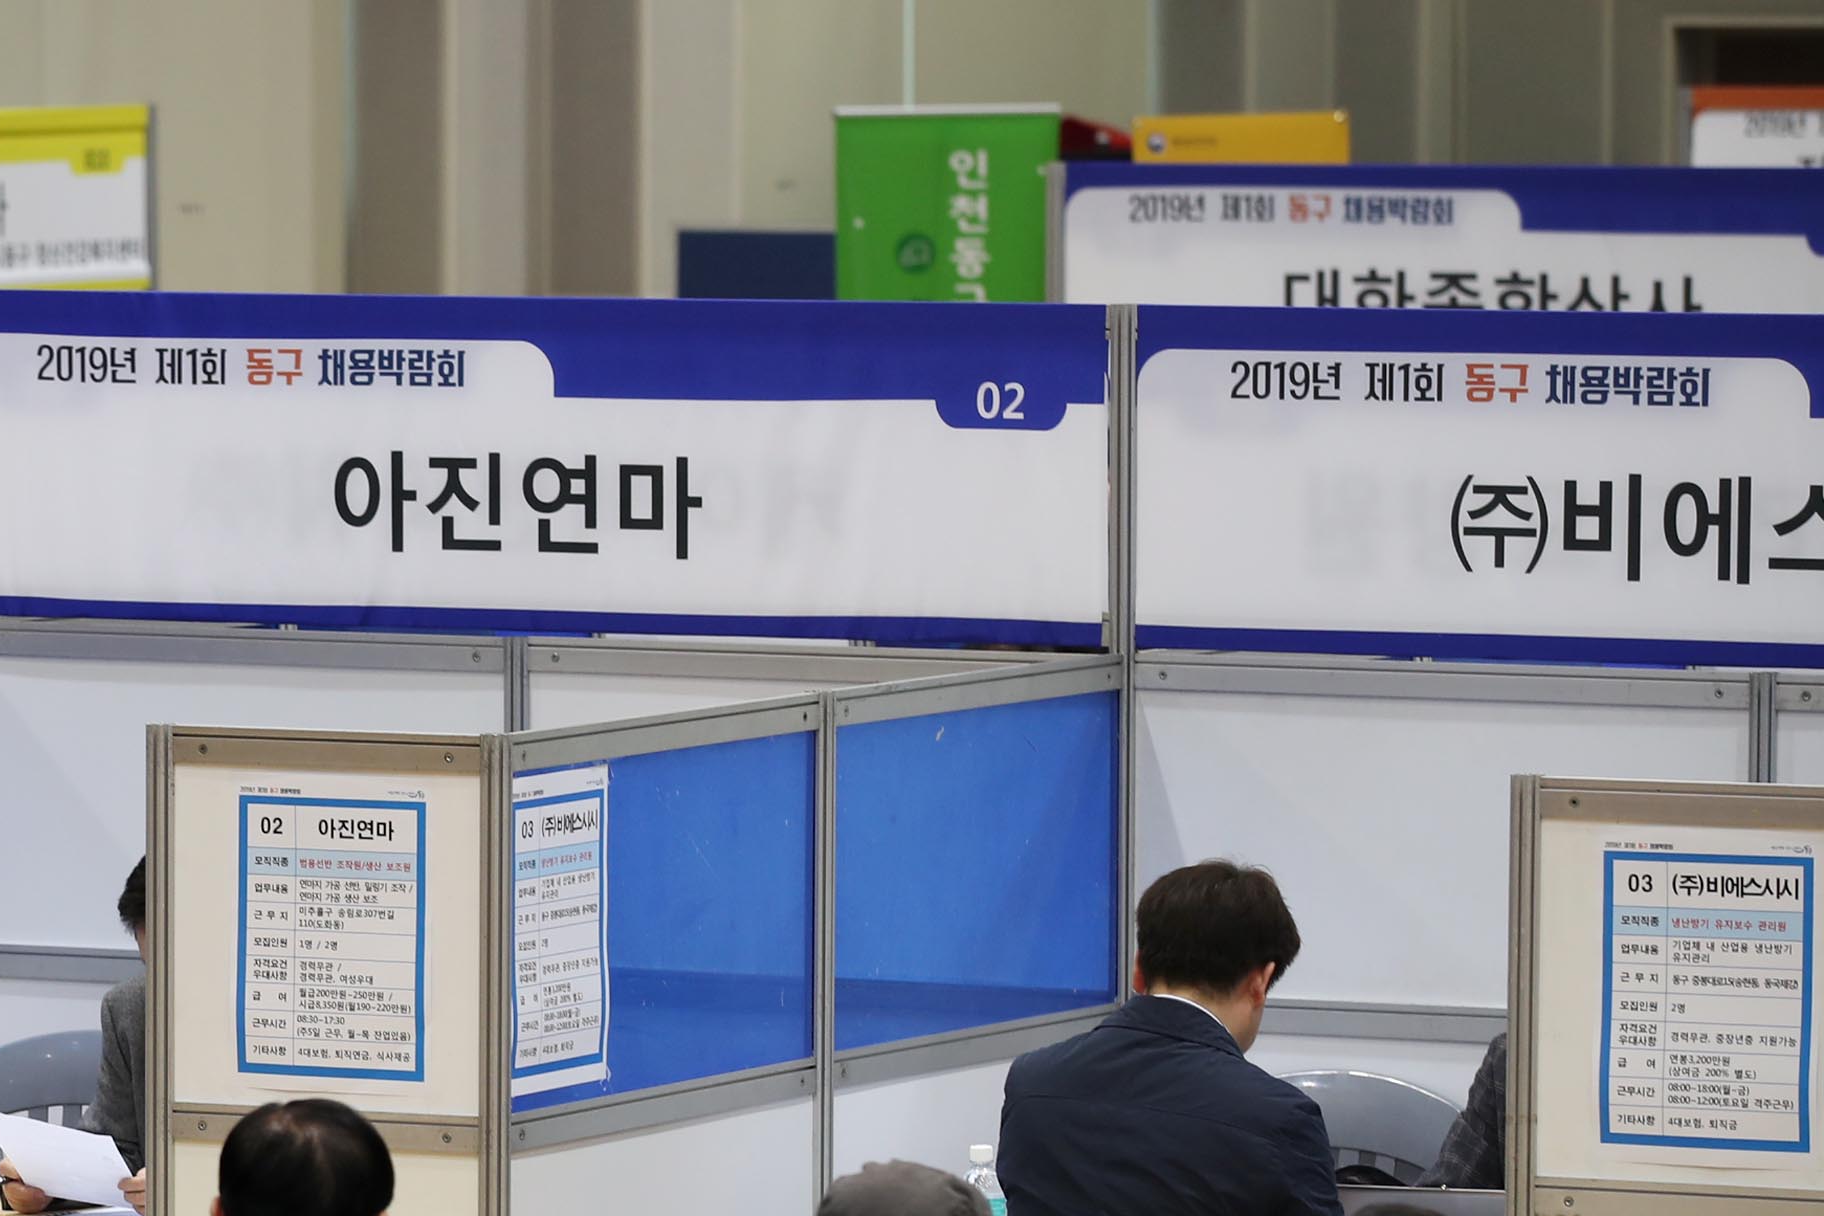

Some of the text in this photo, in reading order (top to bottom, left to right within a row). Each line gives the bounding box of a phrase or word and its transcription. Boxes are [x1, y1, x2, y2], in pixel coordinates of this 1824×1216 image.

[1128, 192, 1454, 227] 2019년 제1회 동구 채용박람회
[36, 344, 466, 390] 2019년 제1회 동구 채용박람회
[1230, 360, 1711, 408] 2019년 제1회 동구 채용박람회
[976, 382, 1025, 420] 02
[333, 450, 703, 560] 아진연마
[261, 816, 394, 841] 02 아진연마
[521, 820, 534, 839] 03
[254, 883, 289, 894] 업무내용
[1628, 873, 1800, 900] 03 (주)비에스시시
[1672, 918, 1710, 930] 냉난방기
[1714, 919, 1752, 930] 유지보수
[1758, 920, 1787, 932] 관리원
[253, 937, 338, 951] 모집인원 1명 2명
[1621, 944, 1659, 955] 업무내용
[1672, 940, 1701, 951] 기업체
[1720, 942, 1749, 953] 산업용
[1754, 943, 1793, 955] 냉난방기
[1672, 952, 1710, 963] 유지관리
[253, 958, 333, 972] 자격요건 경력무관
[253, 970, 287, 981] 우대사항
[339, 974, 374, 985] 여성우대
[1619, 1000, 1686, 1014] 모집인원 2명
[252, 1018, 287, 1029] 근무시간
[1619, 1023, 1657, 1034] 자격요건
[1619, 1035, 1657, 1046] 우대사항
[1759, 1036, 1798, 1048] 지원가능
[253, 1045, 287, 1057] 기타사항
[1617, 1085, 1655, 1097] 근무시간
[1617, 1115, 1655, 1126] 기타사항
[1709, 1119, 1738, 1131] 퇴직금
